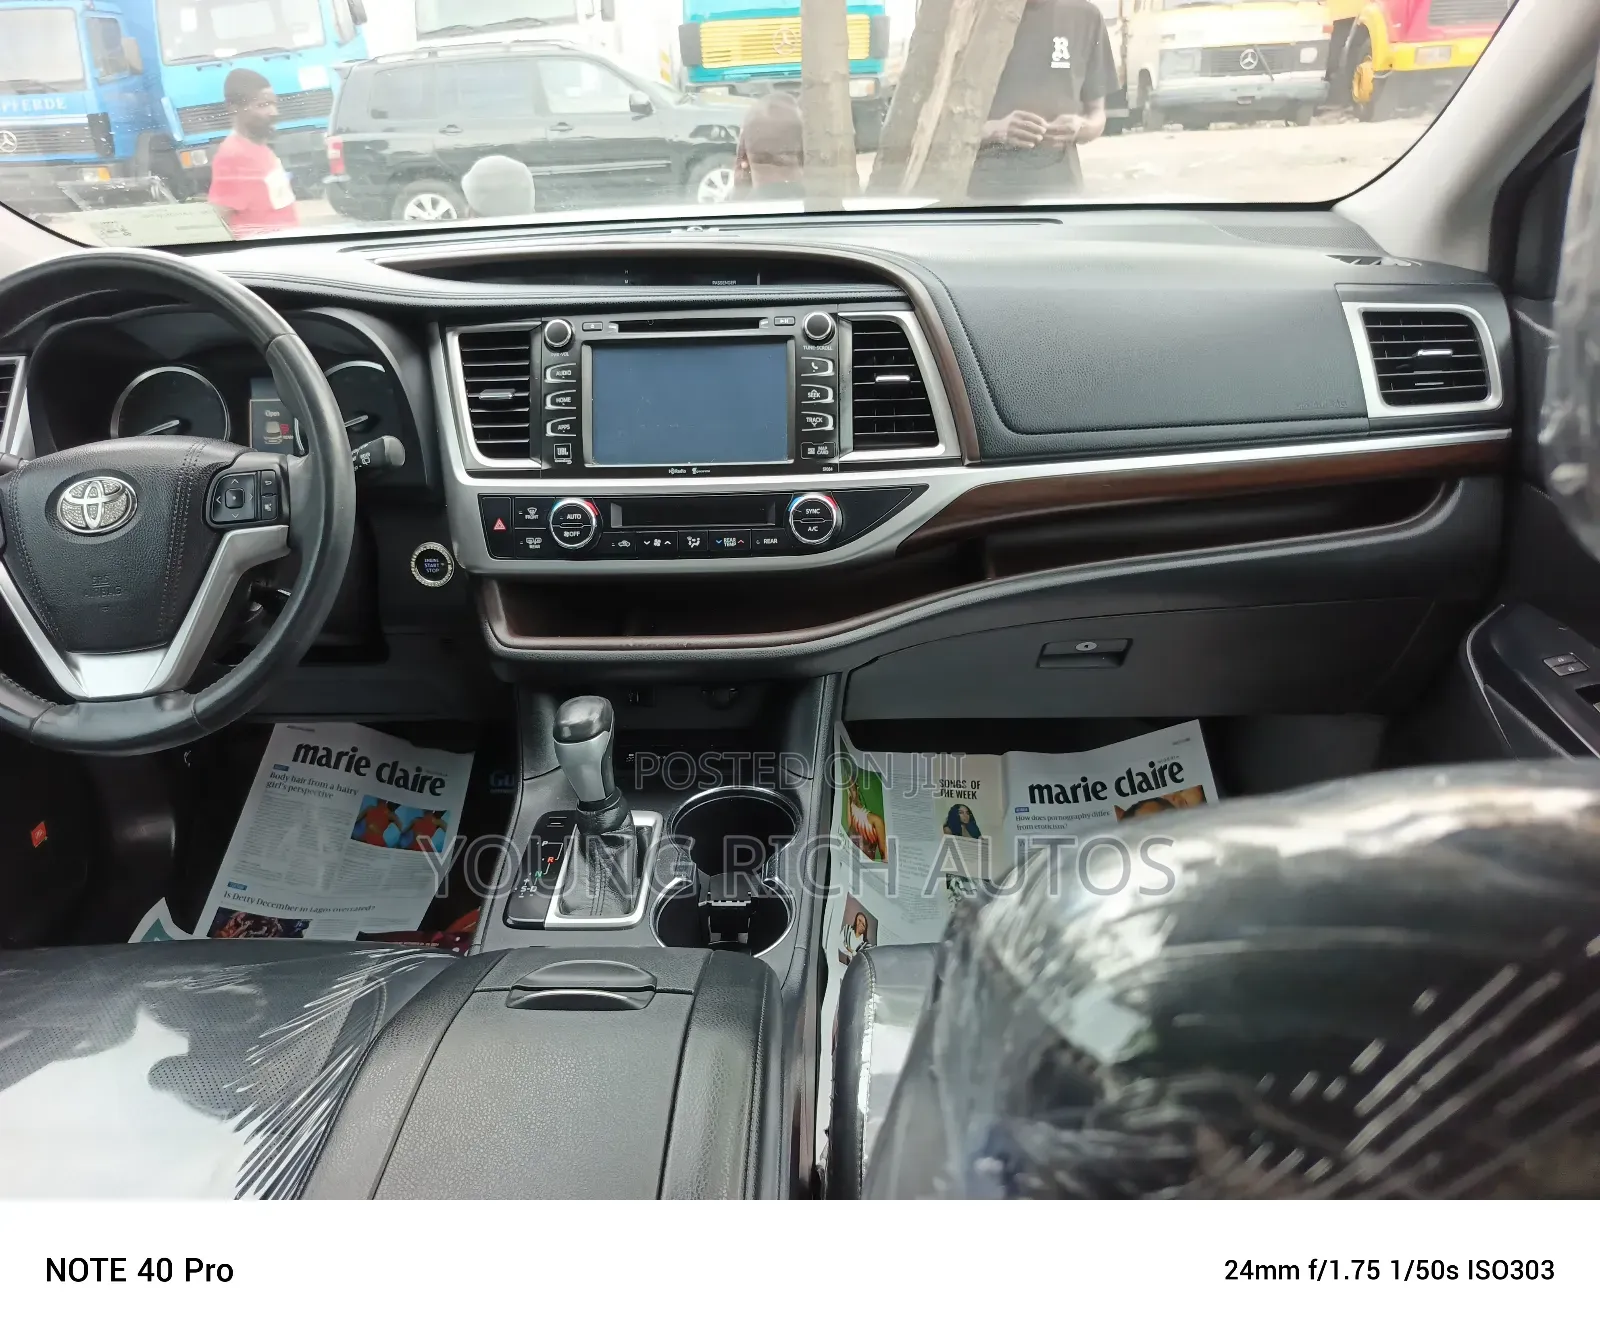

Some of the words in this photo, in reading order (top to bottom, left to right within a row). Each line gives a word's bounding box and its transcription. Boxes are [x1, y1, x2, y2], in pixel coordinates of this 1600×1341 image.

[264, 409, 280, 417] Open
[291, 743, 371, 777] marie
[375, 761, 446, 797] claire
[269, 771, 289, 783] Body
[291, 775, 306, 785] hair
[307, 777, 329, 789] from
[336, 784, 360, 796] hairy
[939, 778, 968, 789] SONGS
[970, 780, 981, 790] OF
[1028, 776, 1108, 805] marie
[1114, 760, 1185, 798] claire
[940, 788, 955, 798] THE
[955, 789, 978, 800] WEEK
[1015, 815, 1033, 823] How
[1047, 812, 1091, 823] pornography
[1016, 823, 1034, 831] from
[535, 870, 542, 878] N
[223, 890, 231, 899] Is
[256, 898, 298, 912] December
